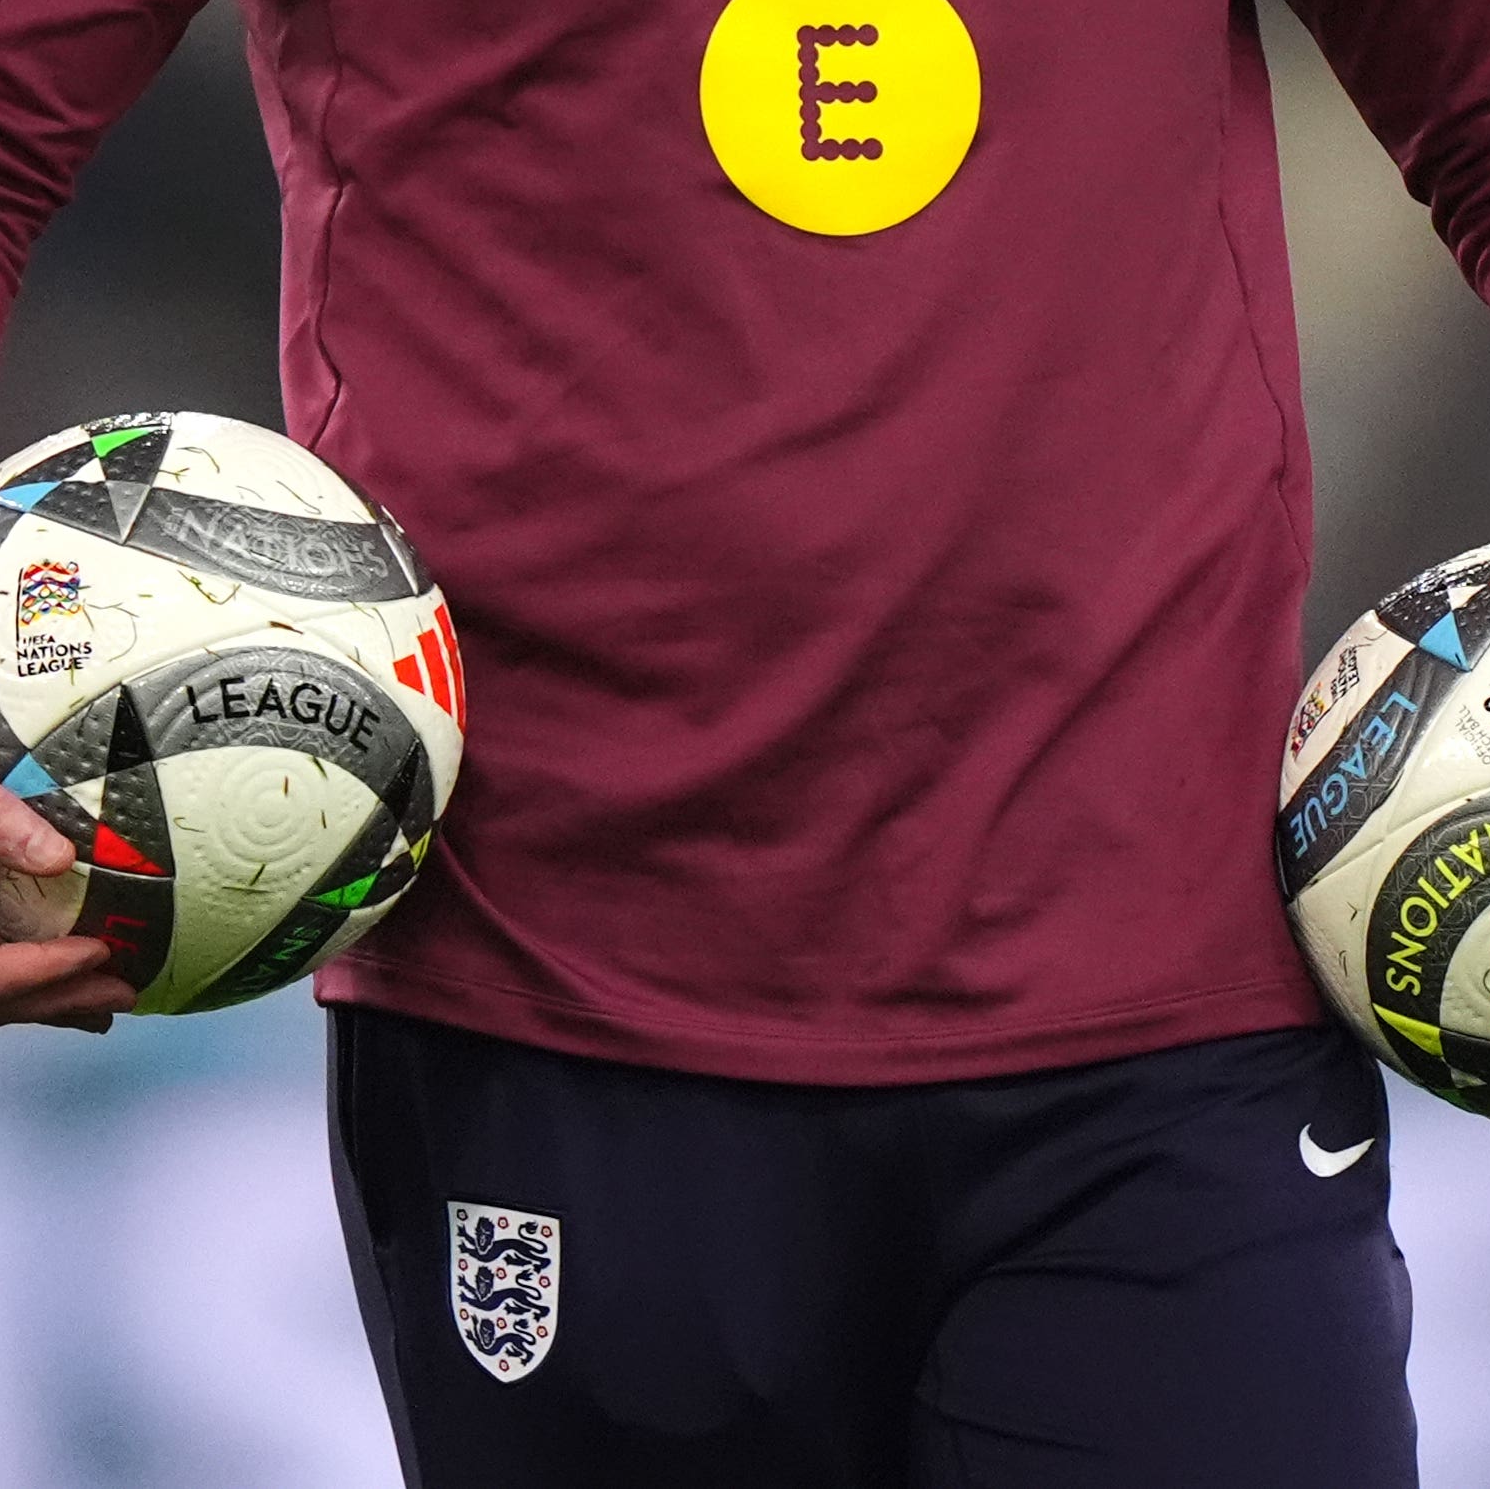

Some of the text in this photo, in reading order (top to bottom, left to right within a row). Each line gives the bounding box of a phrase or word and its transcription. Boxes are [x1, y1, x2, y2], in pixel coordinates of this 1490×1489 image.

[17, 641, 93, 660] NATIONS
[17, 656, 87, 678] LEAGUE
[185, 676, 381, 754] LEAGUE
[1458, 704, 1480, 731] BALL
[1289, 691, 1419, 860] LEAGUE
